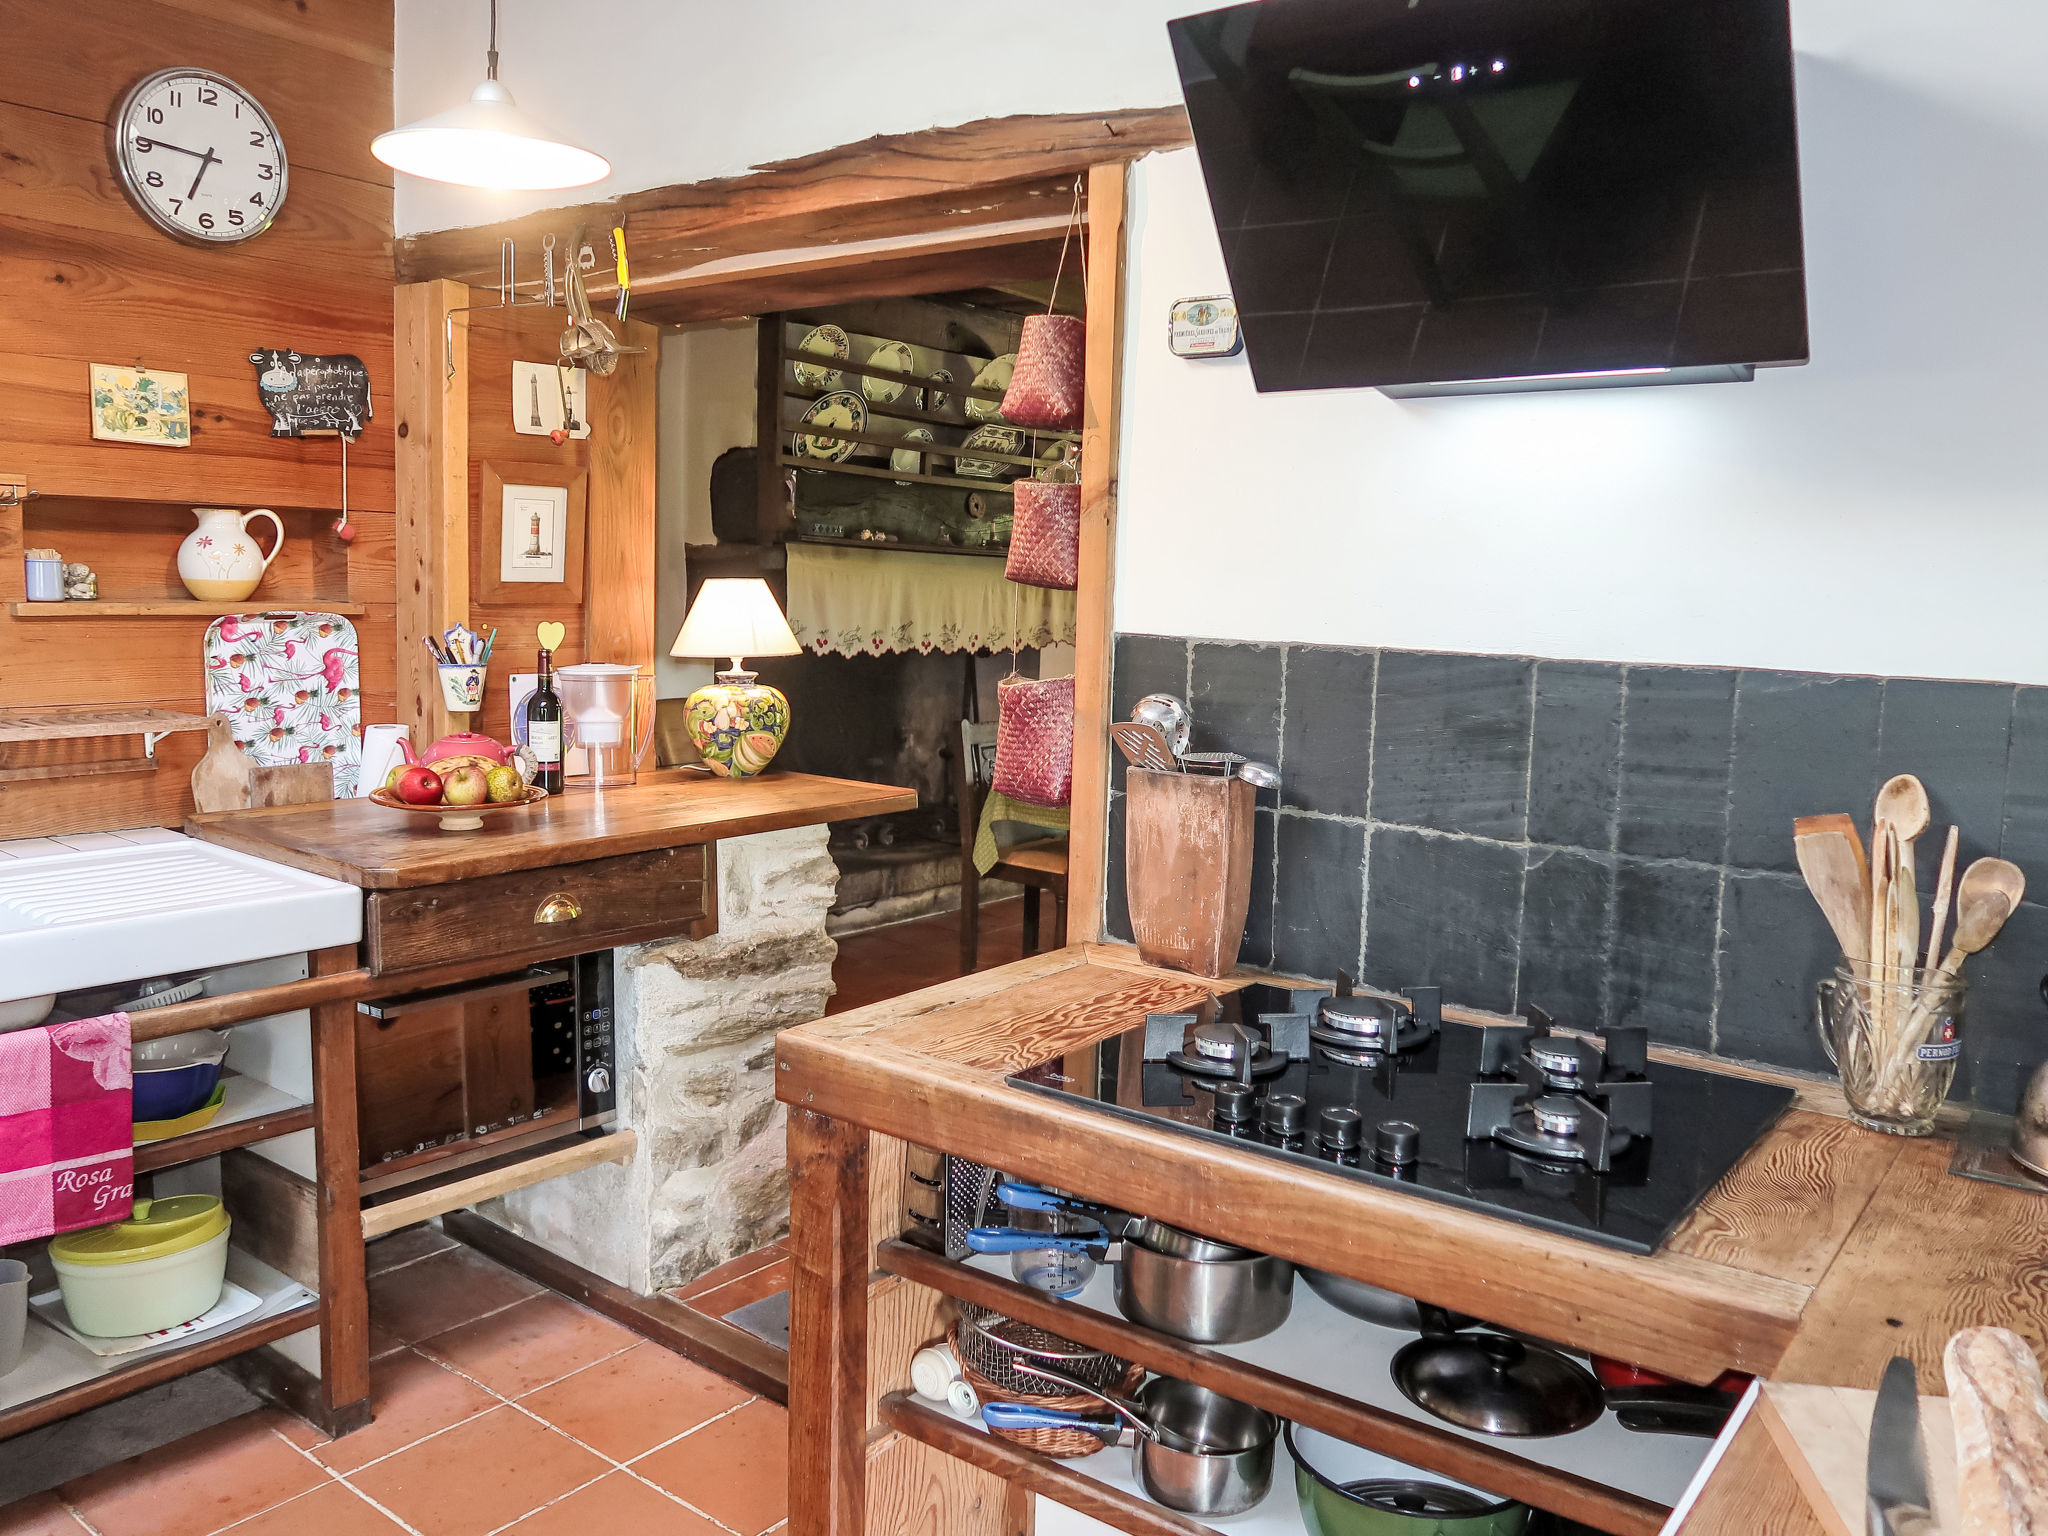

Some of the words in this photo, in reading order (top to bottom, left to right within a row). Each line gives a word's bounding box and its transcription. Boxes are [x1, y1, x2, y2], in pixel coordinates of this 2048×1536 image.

[170, 90, 181, 108] 11
[198, 86, 218, 107] 12
[147, 106, 164, 125] 10
[235, 103, 239, 119] 1
[135, 136, 153, 154] 9
[250, 131, 265, 148] 2
[145, 171, 164, 188] 8
[257, 163, 273, 181] 3
[169, 198, 183, 216] 7
[249, 191, 264, 207] 4
[199, 213, 214, 230] 6
[228, 209, 244, 226] 5
[273, 393, 287, 402] ne
[293, 393, 310, 404] pas
[315, 390, 353, 405] prendre
[1920, 1047, 1952, 1057] PERNOD
[57, 1167, 114, 1193] Rosa
[93, 1183, 133, 1211] Gra
